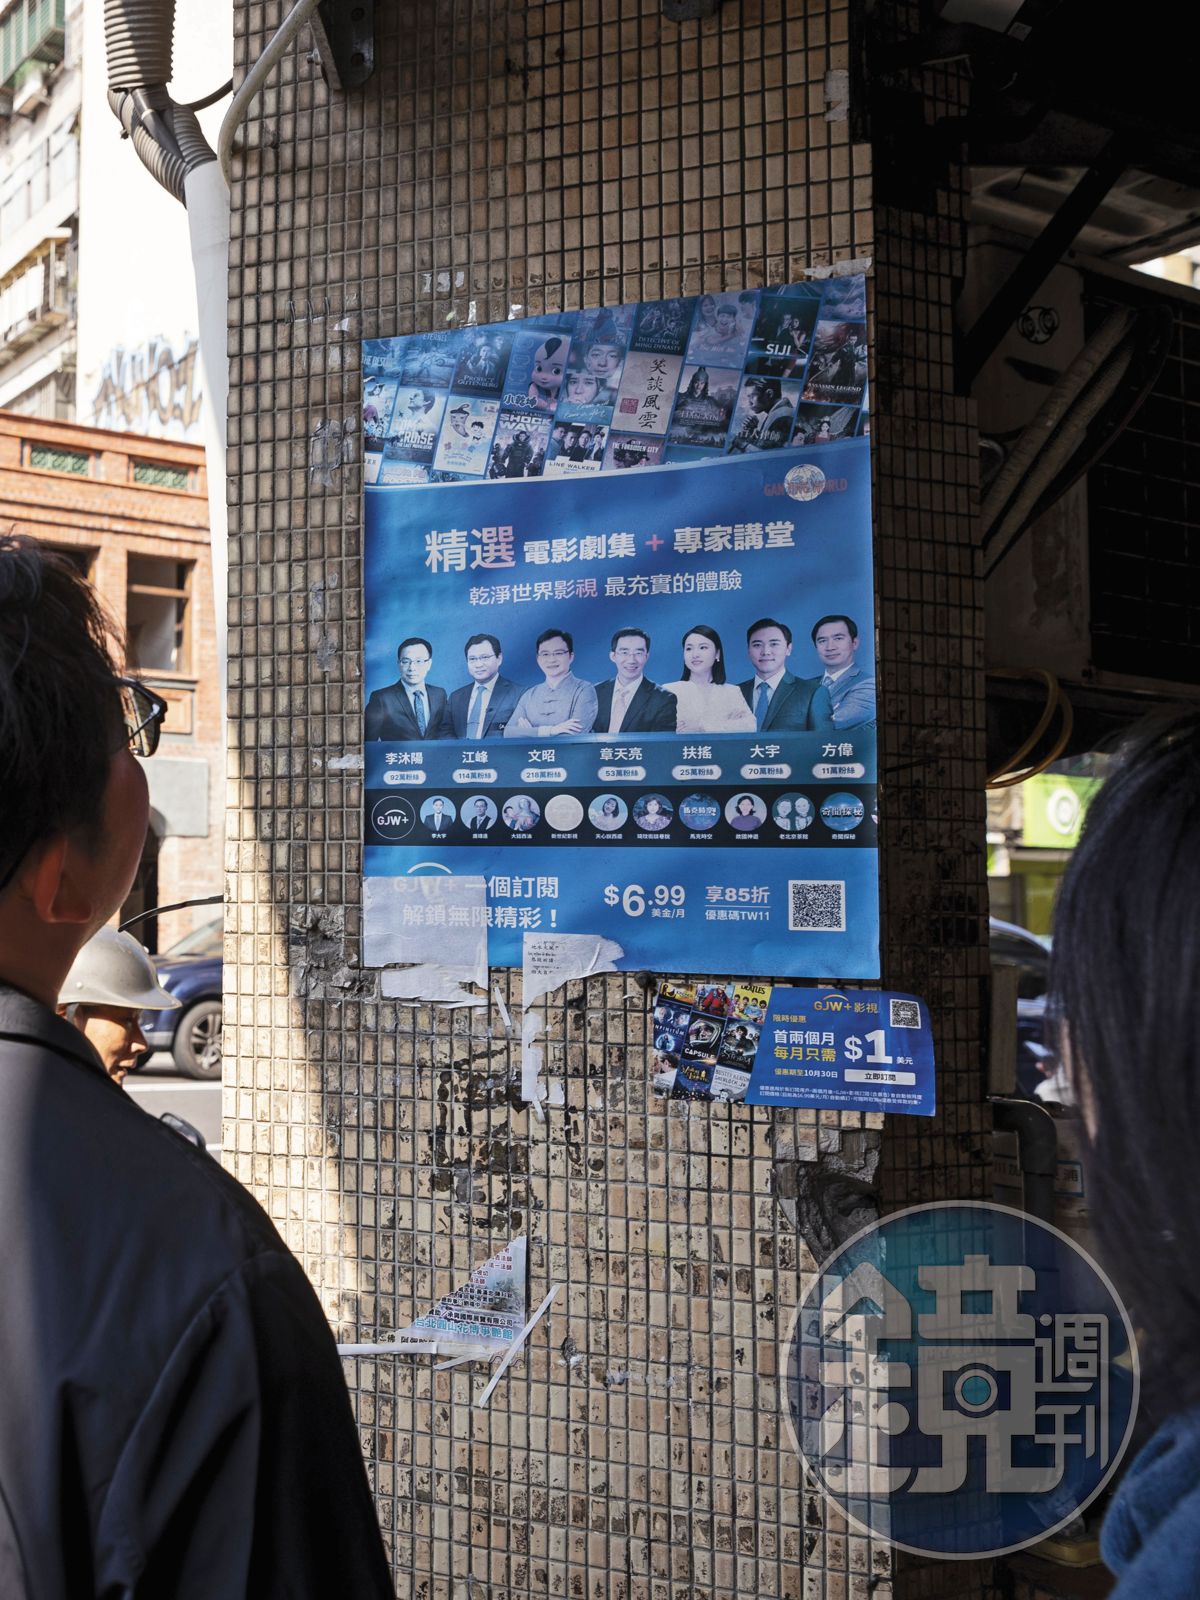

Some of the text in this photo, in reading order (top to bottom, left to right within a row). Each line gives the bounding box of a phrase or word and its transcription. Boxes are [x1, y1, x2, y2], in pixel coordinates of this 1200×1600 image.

[766, 343, 792, 356] SIJI
[638, 358, 668, 429] 笑談風雲
[499, 414, 552, 425] SHOCK
[499, 421, 551, 433] WAVE
[424, 525, 516, 574] 精選
[523, 533, 636, 565] 電影劇集
[673, 520, 796, 555] 專家講堂
[469, 569, 742, 606] 乾淨世界影視 最充實的體驗
[528, 749, 556, 763] 文昭
[600, 747, 643, 761] 章天亮
[682, 745, 712, 760] 扶搖
[750, 744, 780, 759] 大宇
[821, 742, 854, 757] 方偉
[385, 752, 424, 765] 李沐陽
[462, 751, 489, 764] 江峰
[377, 814, 410, 826] GJW+
[464, 876, 559, 899] 一個訂閱
[705, 885, 770, 904] 享85折
[604, 884, 686, 917] $6.99
[651, 908, 685, 919] 美金/月
[705, 909, 770, 922] 優惠碼TW11
[814, 1000, 880, 1014] GJW+ 影視
[773, 1029, 835, 1046] 首兩個月
[684, 1047, 715, 1060] CAPSULE
[773, 1046, 837, 1063] 每月只需
[844, 1029, 893, 1064] $1
[896, 1056, 914, 1065] 美元
[864, 1072, 897, 1082] 立即訂閱
